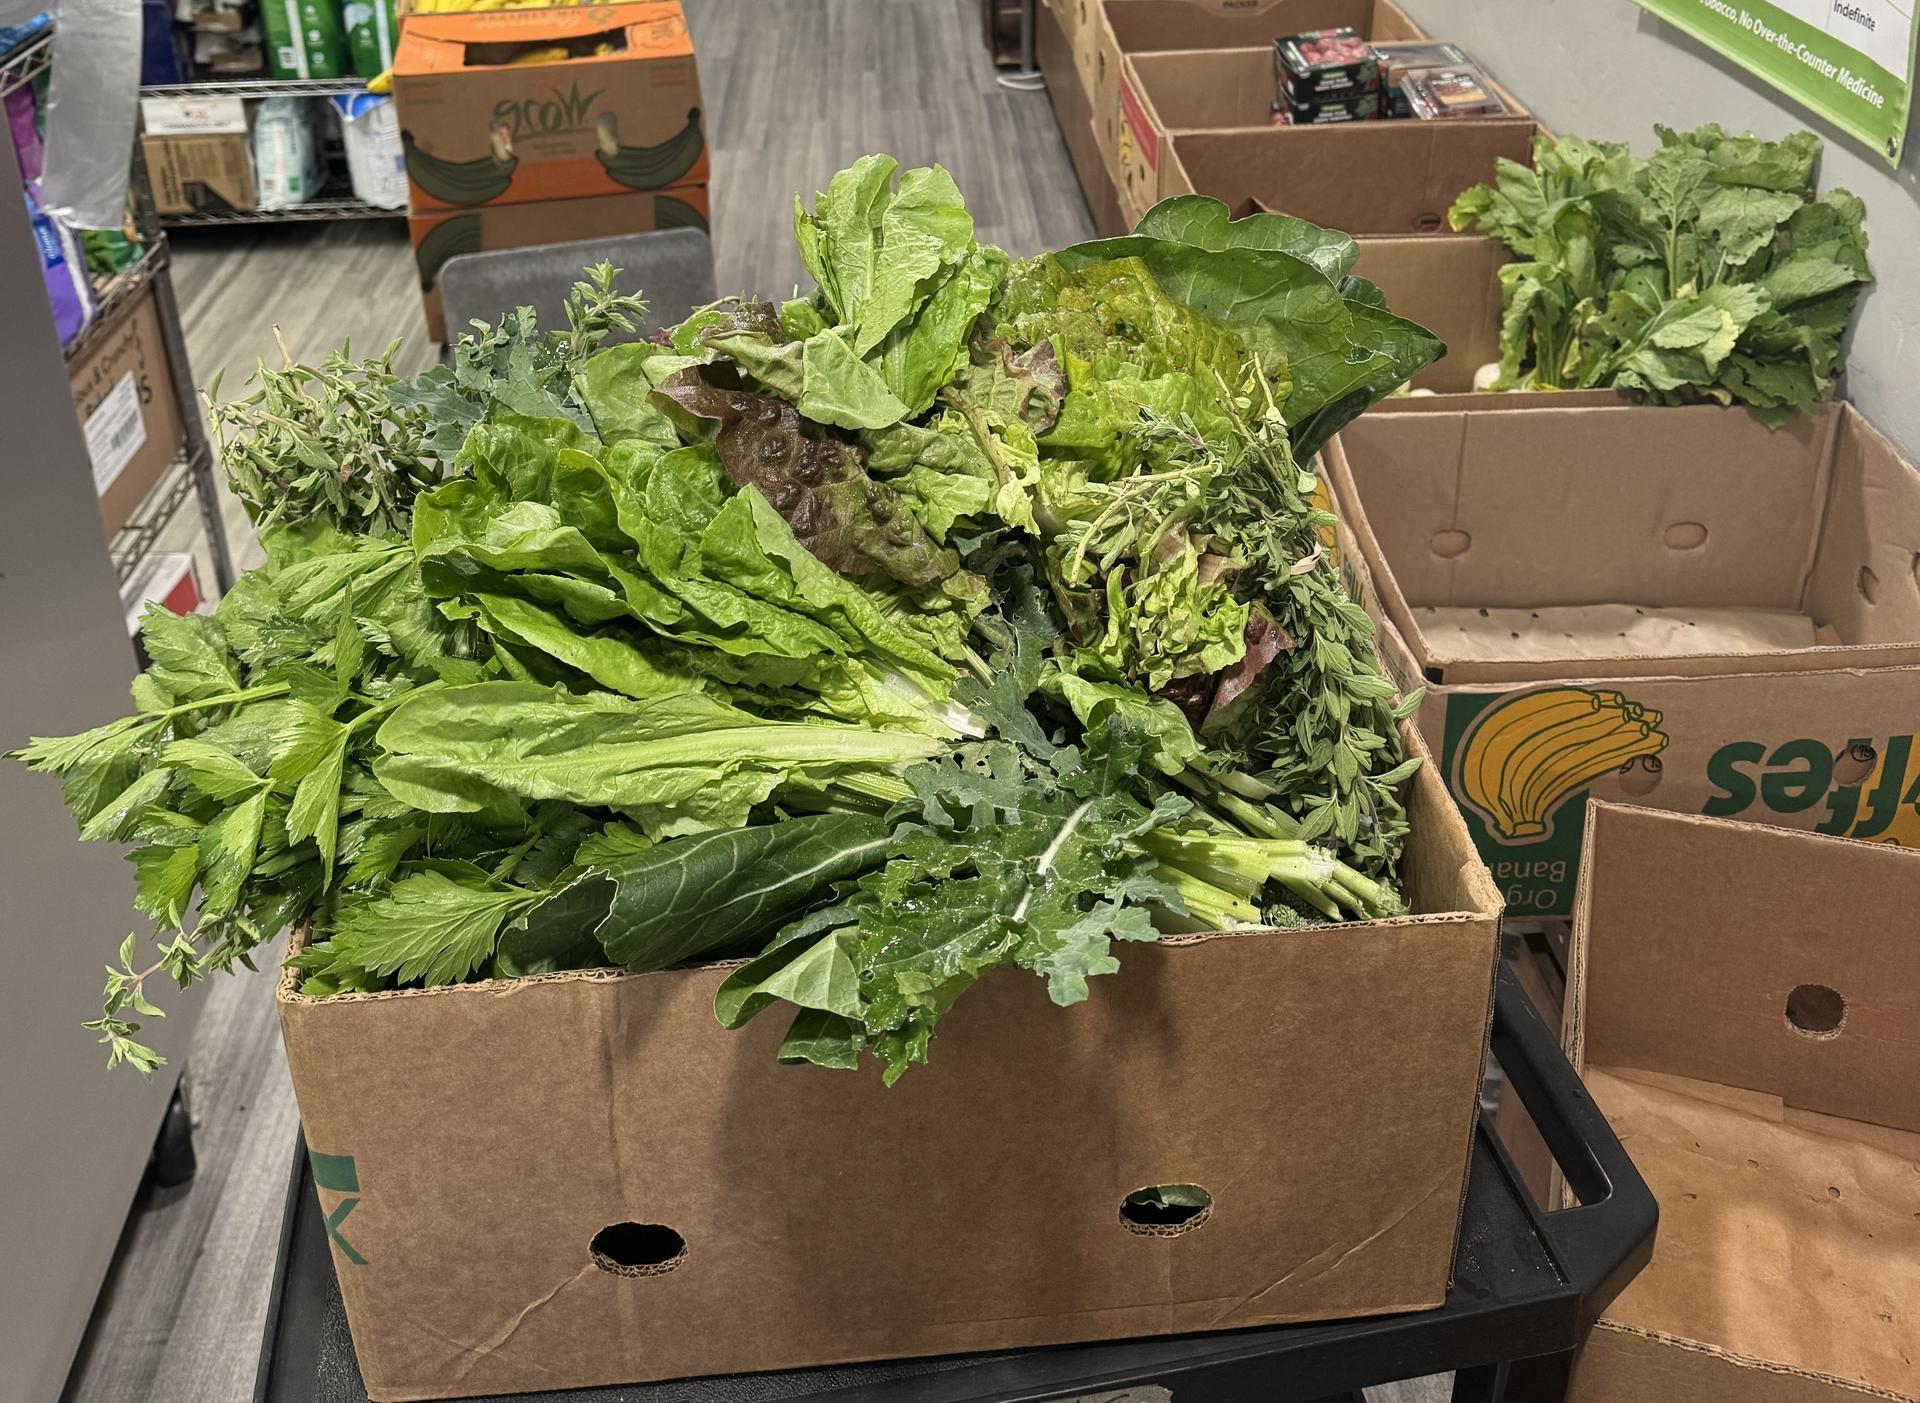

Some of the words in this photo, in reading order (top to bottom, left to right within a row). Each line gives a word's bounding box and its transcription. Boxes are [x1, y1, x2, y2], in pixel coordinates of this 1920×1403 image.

[1833, 0, 1877, 32] Indefinite
[1700, 0, 1737, 24] obacco,
[1738, 9, 1753, 30] No
[1753, 18, 1838, 79] Over-the-Counter
[1836, 67, 1884, 110] Medicine
[1490, 860, 1566, 883] Bana
